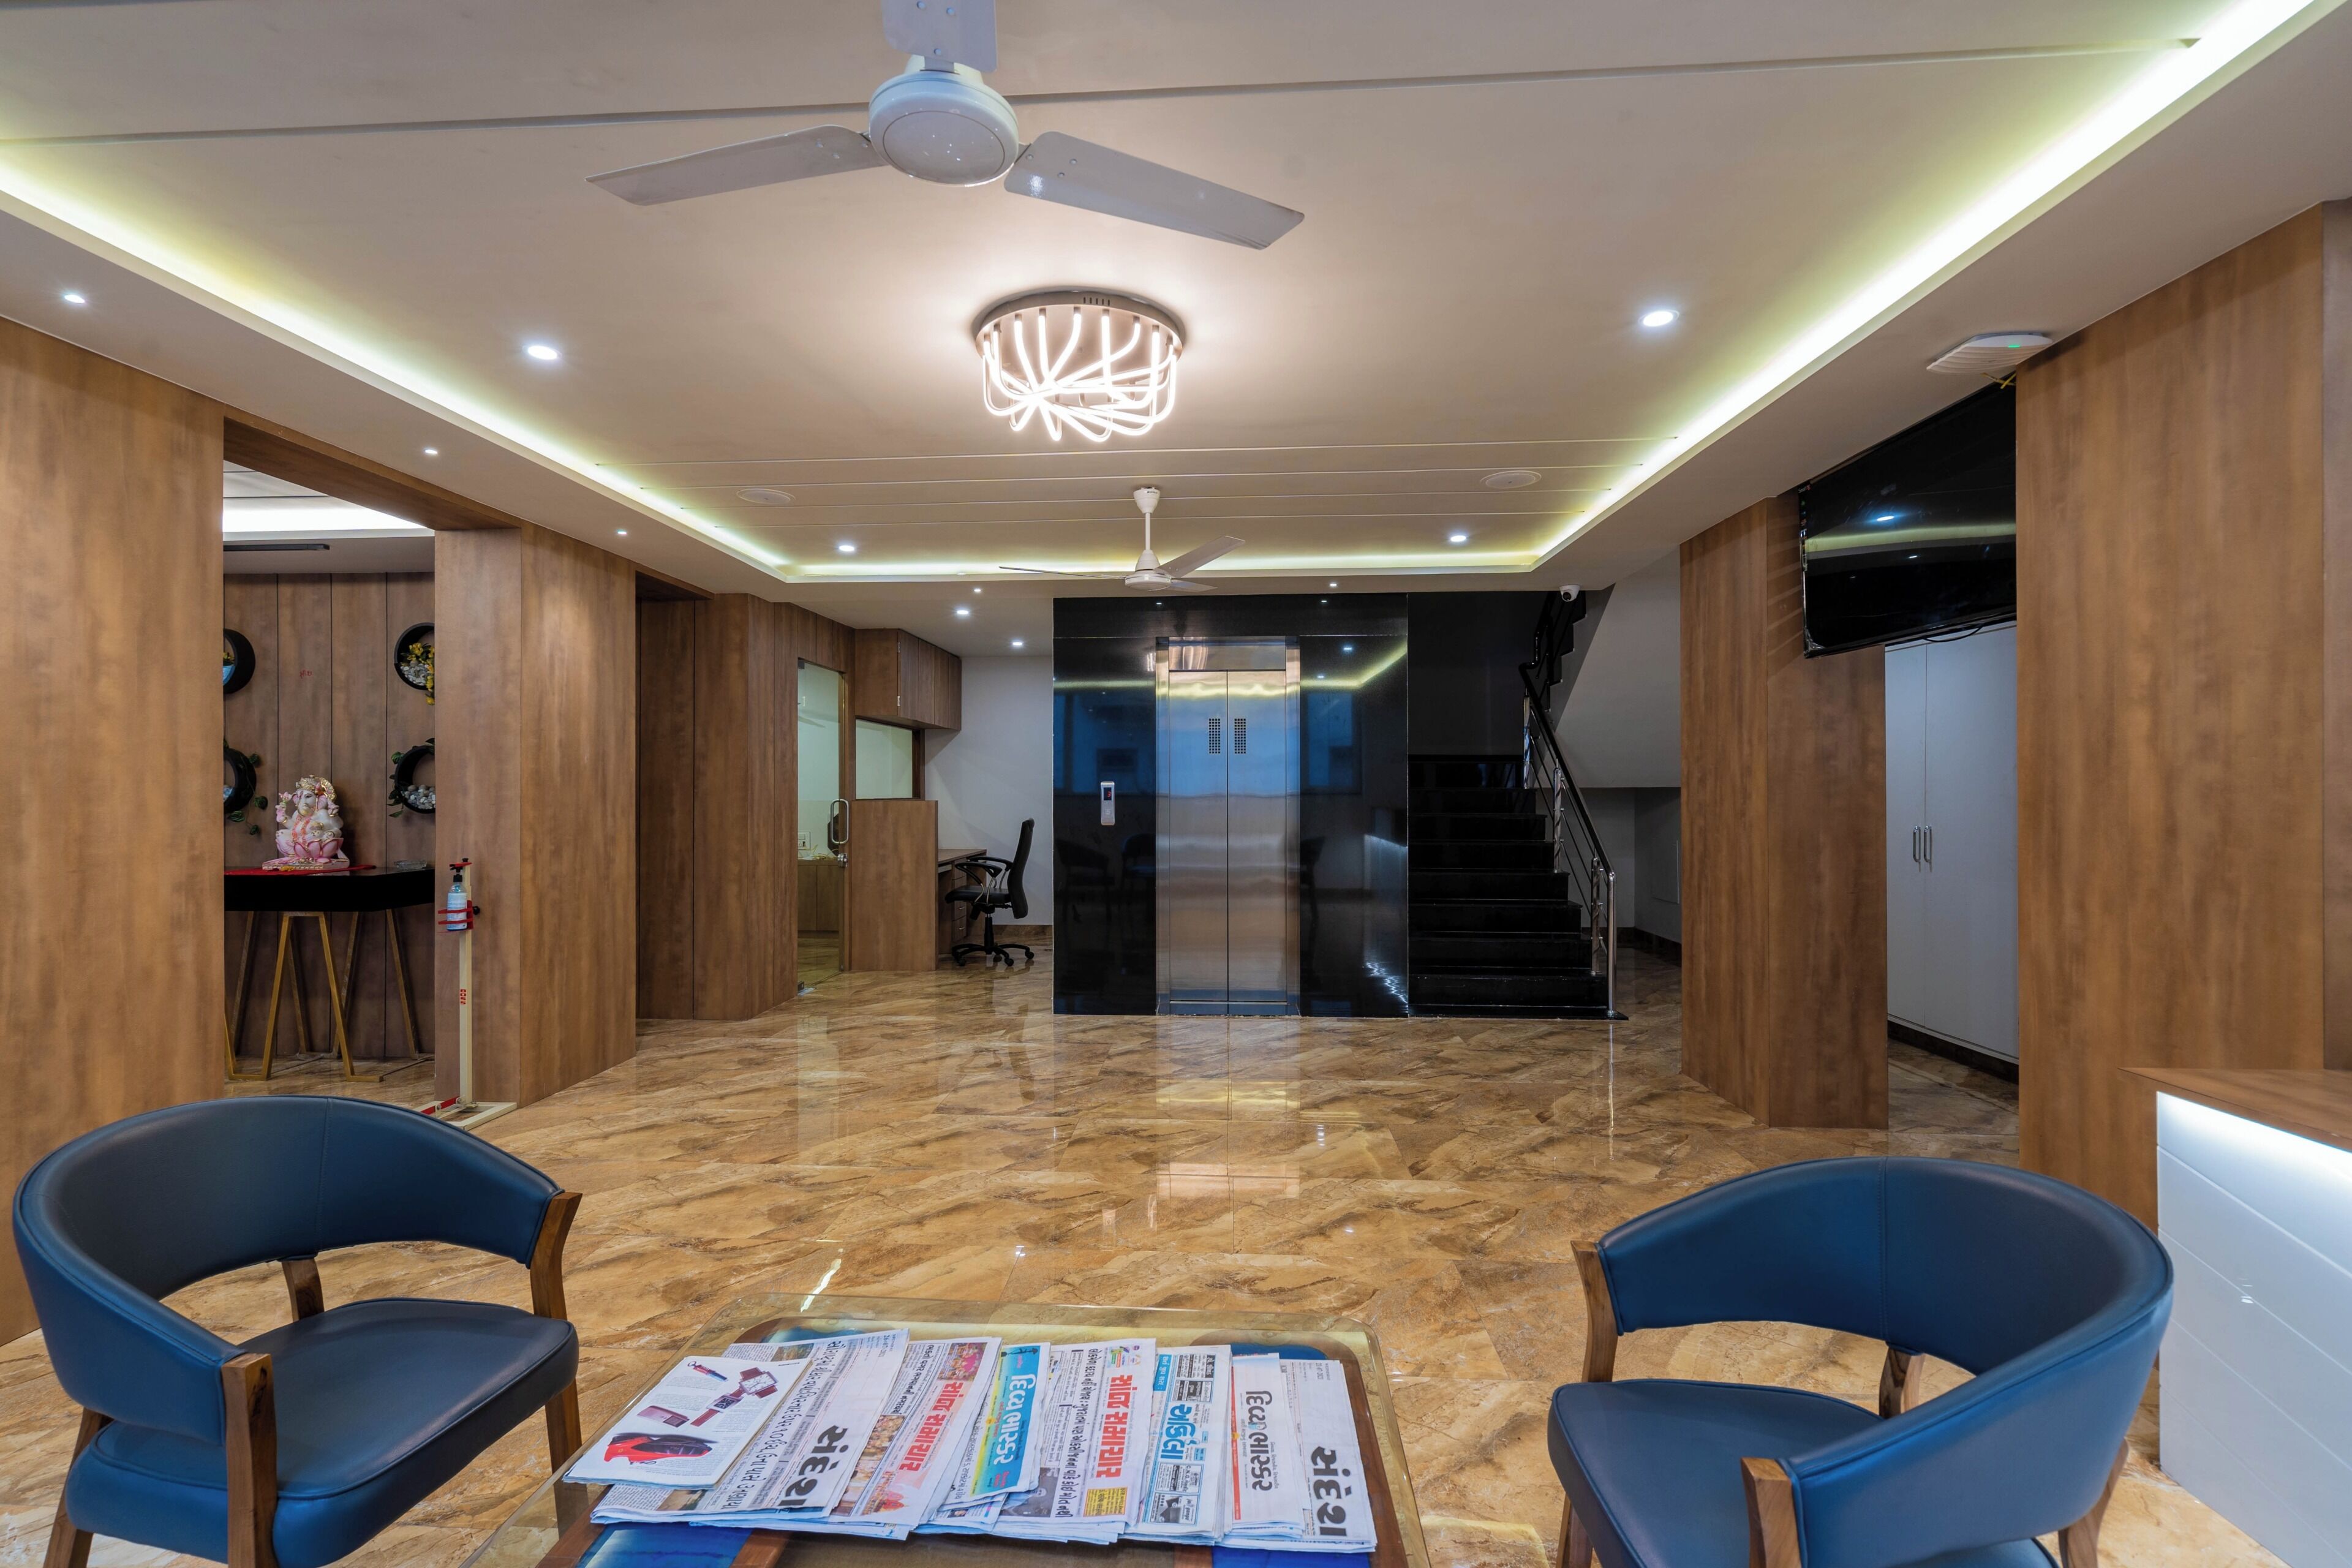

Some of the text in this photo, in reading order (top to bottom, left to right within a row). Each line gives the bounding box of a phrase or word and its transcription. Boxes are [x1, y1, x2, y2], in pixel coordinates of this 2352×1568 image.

[916, 1360, 927, 1371] વગર
[1083, 1366, 1095, 1377] કદાચ
[902, 1372, 922, 1395] ભગવાનની
[931, 1382, 964, 1411] સાંજ
[1005, 1374, 1036, 1411] દિવ્ય
[1106, 1374, 1137, 1409] સાંજ
[774, 1414, 801, 1428] ઉપર
[1071, 1404, 1090, 1425] ગુજરાતમાં
[898, 1414, 946, 1471] સમાચાર
[992, 1412, 1021, 1465] ભાસ્કર
[1071, 1425, 1084, 1434] પણ
[1159, 1404, 1196, 1460] અકિલા
[1245, 1391, 1272, 1491] દિવ્ય ભાસ્કર
[1095, 1412, 1128, 1478] સમાચાર
[750, 1453, 778, 1466] ઉના
[777, 1425, 848, 1507] સંદેશ
[740, 1467, 766, 1481] પાસે
[1057, 1493, 1077, 1504] મોત
[1310, 1446, 1351, 1536] સંદેશ
[1054, 1506, 1073, 1518] નથી
